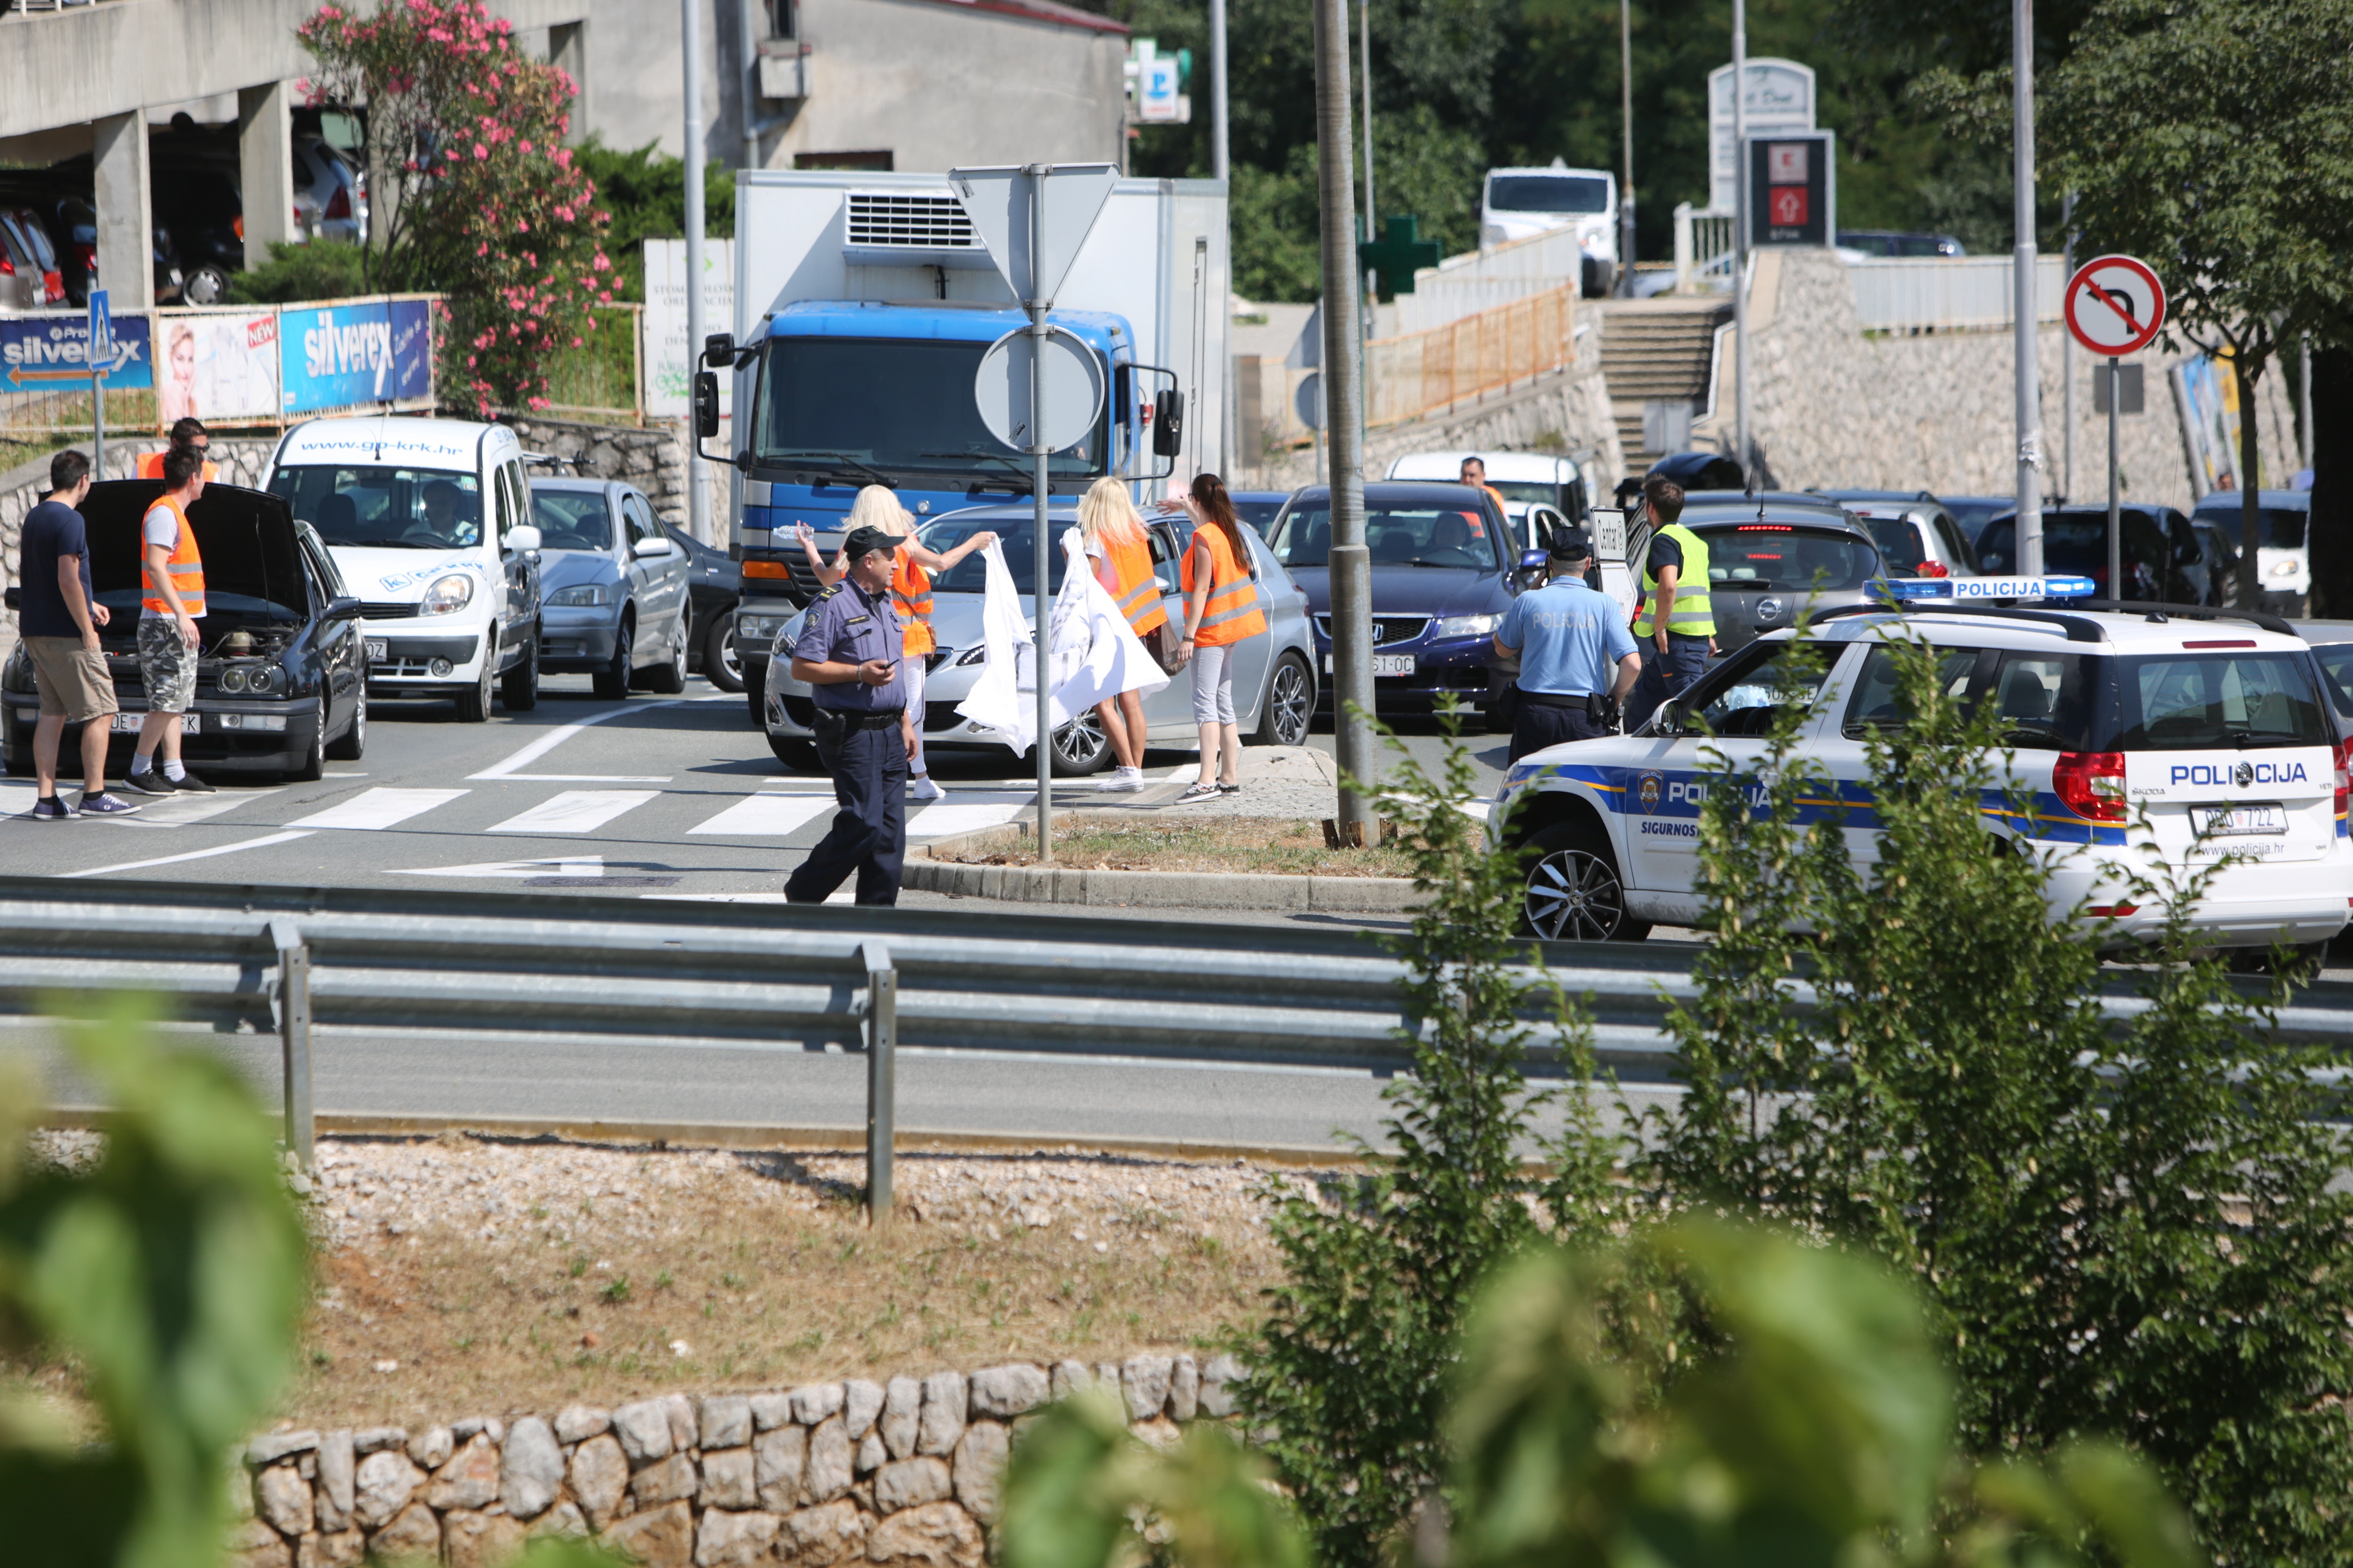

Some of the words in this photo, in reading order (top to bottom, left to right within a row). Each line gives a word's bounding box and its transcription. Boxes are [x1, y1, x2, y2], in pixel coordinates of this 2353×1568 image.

[248, 322, 274, 347] NEW
[4, 336, 142, 372] silvex
[304, 311, 394, 396] silverex
[301, 441, 463, 455] www.gp-krk.hr
[1598, 519, 1617, 551] Centar
[1957, 582, 2041, 596] POLICIJA
[1533, 612, 1596, 630] POLICIJA
[1640, 771, 1662, 780] POLICIJA
[1668, 782, 1774, 808] POLCIJA
[2132, 787, 2165, 795] ŠKODA
[2245, 808, 2274, 826] 722
[2201, 842, 2285, 857] www.policija.hr
